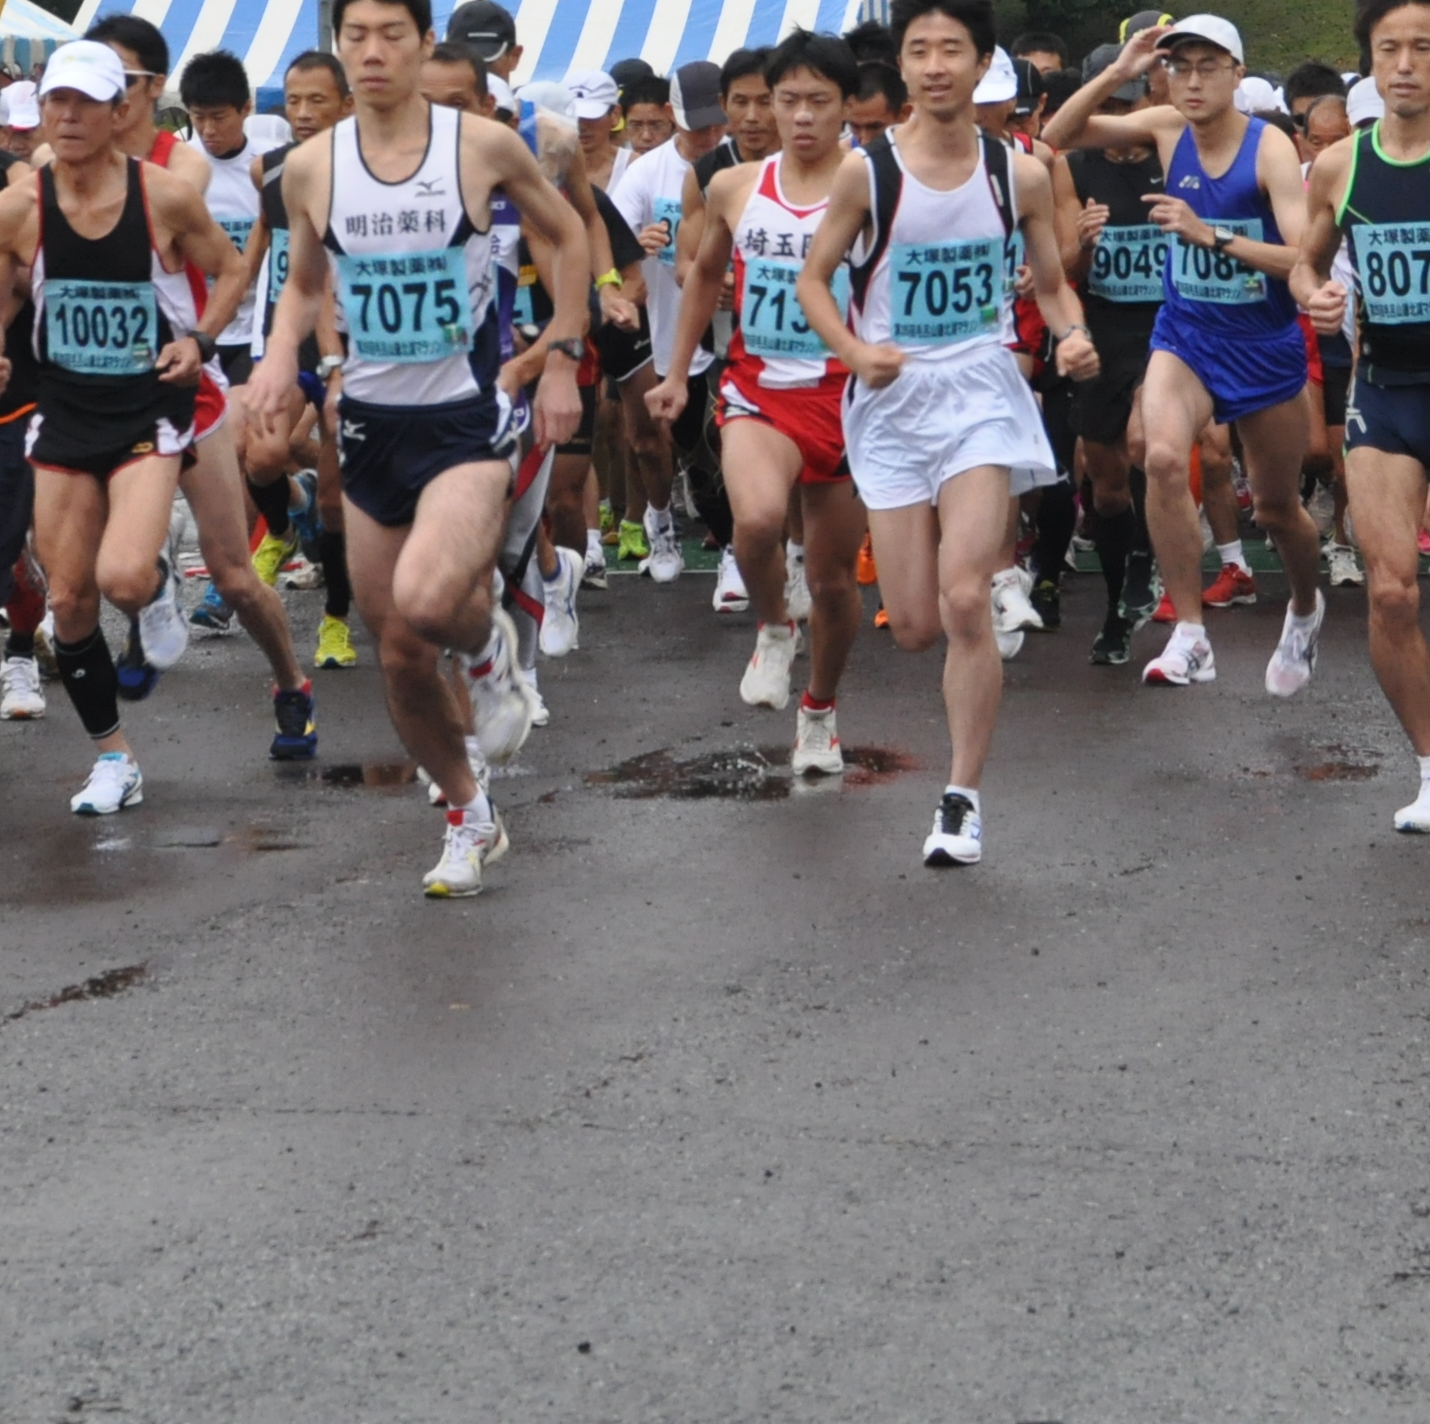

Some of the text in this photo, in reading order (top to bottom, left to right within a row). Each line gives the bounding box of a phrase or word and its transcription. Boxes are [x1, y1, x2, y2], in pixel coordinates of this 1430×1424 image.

[345, 209, 447, 238] 明治薬科
[1093, 243, 1170, 281] 9049
[350, 278, 461, 334] 7075
[897, 263, 994, 317] 7053
[55, 303, 150, 349] 10032
